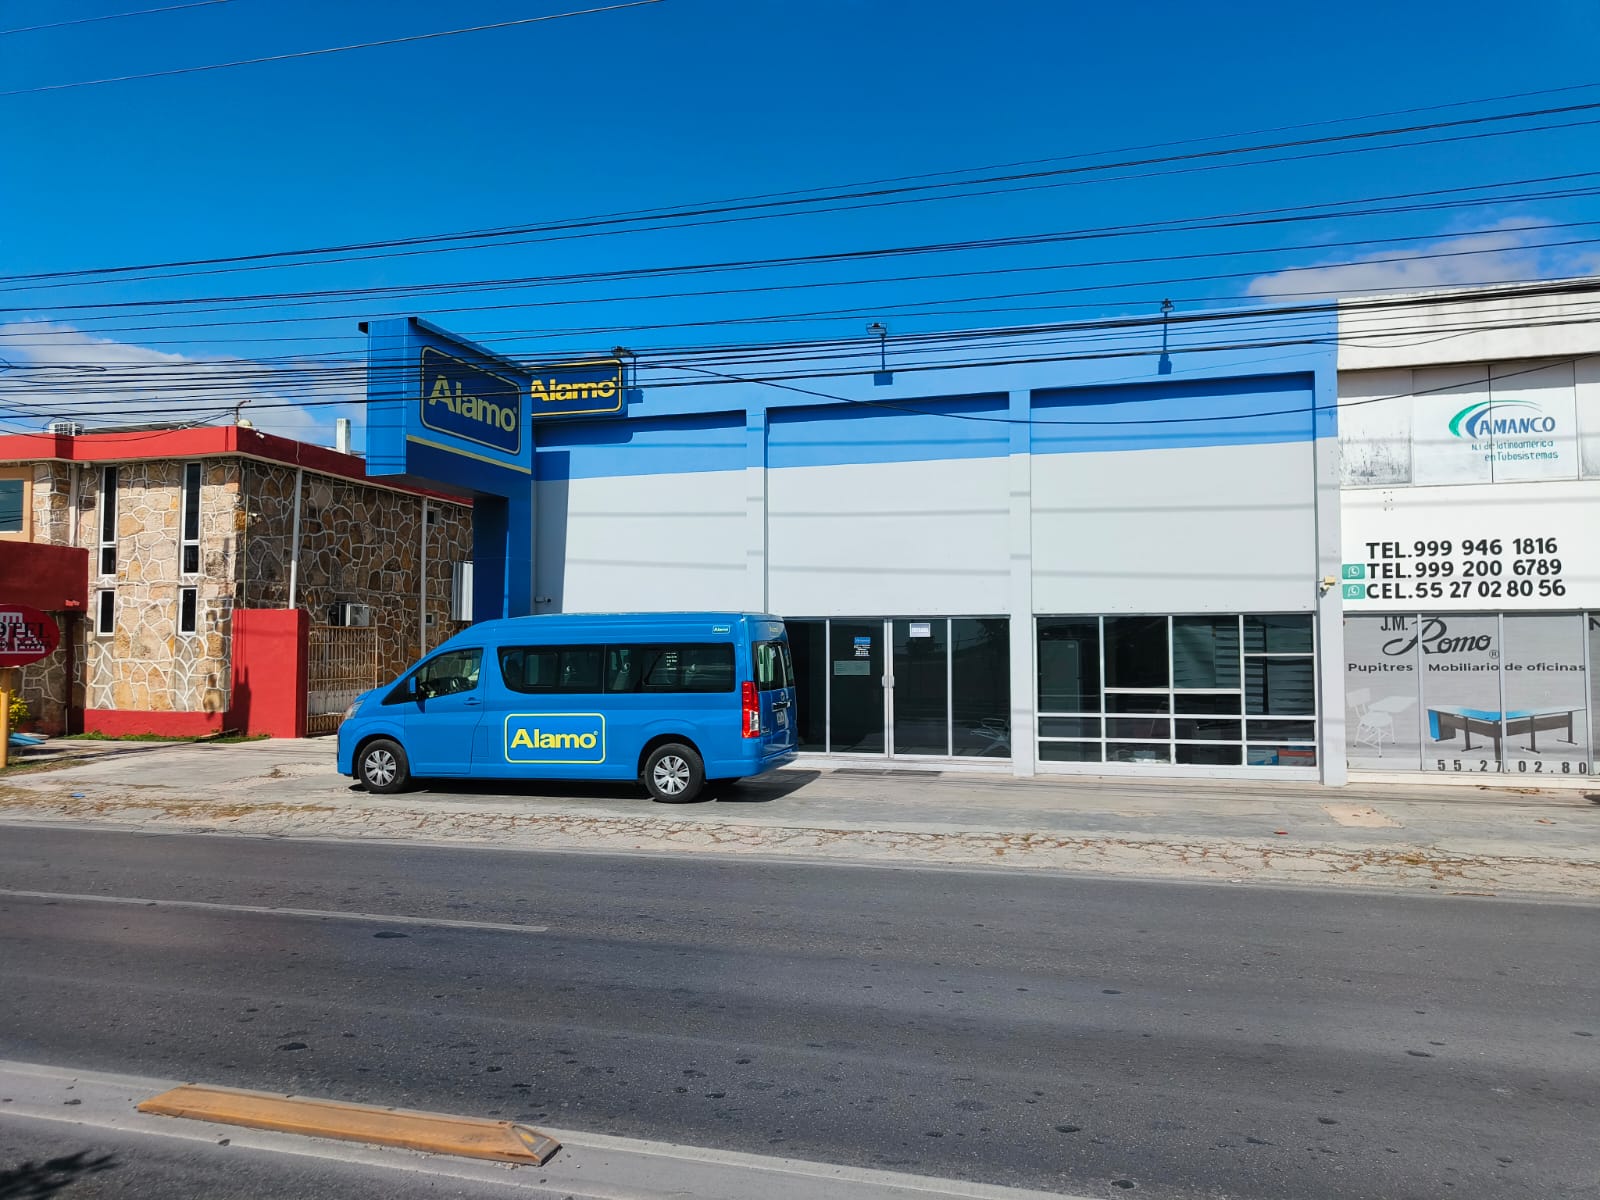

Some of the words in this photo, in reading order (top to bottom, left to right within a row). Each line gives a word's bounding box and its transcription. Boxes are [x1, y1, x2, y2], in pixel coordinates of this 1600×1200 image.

[531, 379, 616, 402] Alamo
[429, 374, 516, 432] Alamo
[1479, 416, 1556, 436] AMANCO
[1461, 539, 1503, 556] 946
[1512, 537, 1558, 555] 1816
[1462, 560, 1503, 577] 200
[1512, 558, 1562, 576] 6789
[1449, 581, 1472, 598] 27
[1477, 580, 1502, 598] 02
[1506, 580, 1534, 597] 80
[1537, 578, 1566, 597] 56
[1380, 615, 1408, 632] J.M.
[1382, 616, 1492, 656] Romo
[1347, 662, 1414, 674] Pupitres
[1428, 662, 1499, 672] Mobiliario
[1504, 662, 1523, 672] de
[1526, 661, 1586, 672] oficinas
[510, 728, 597, 750] Alamo
